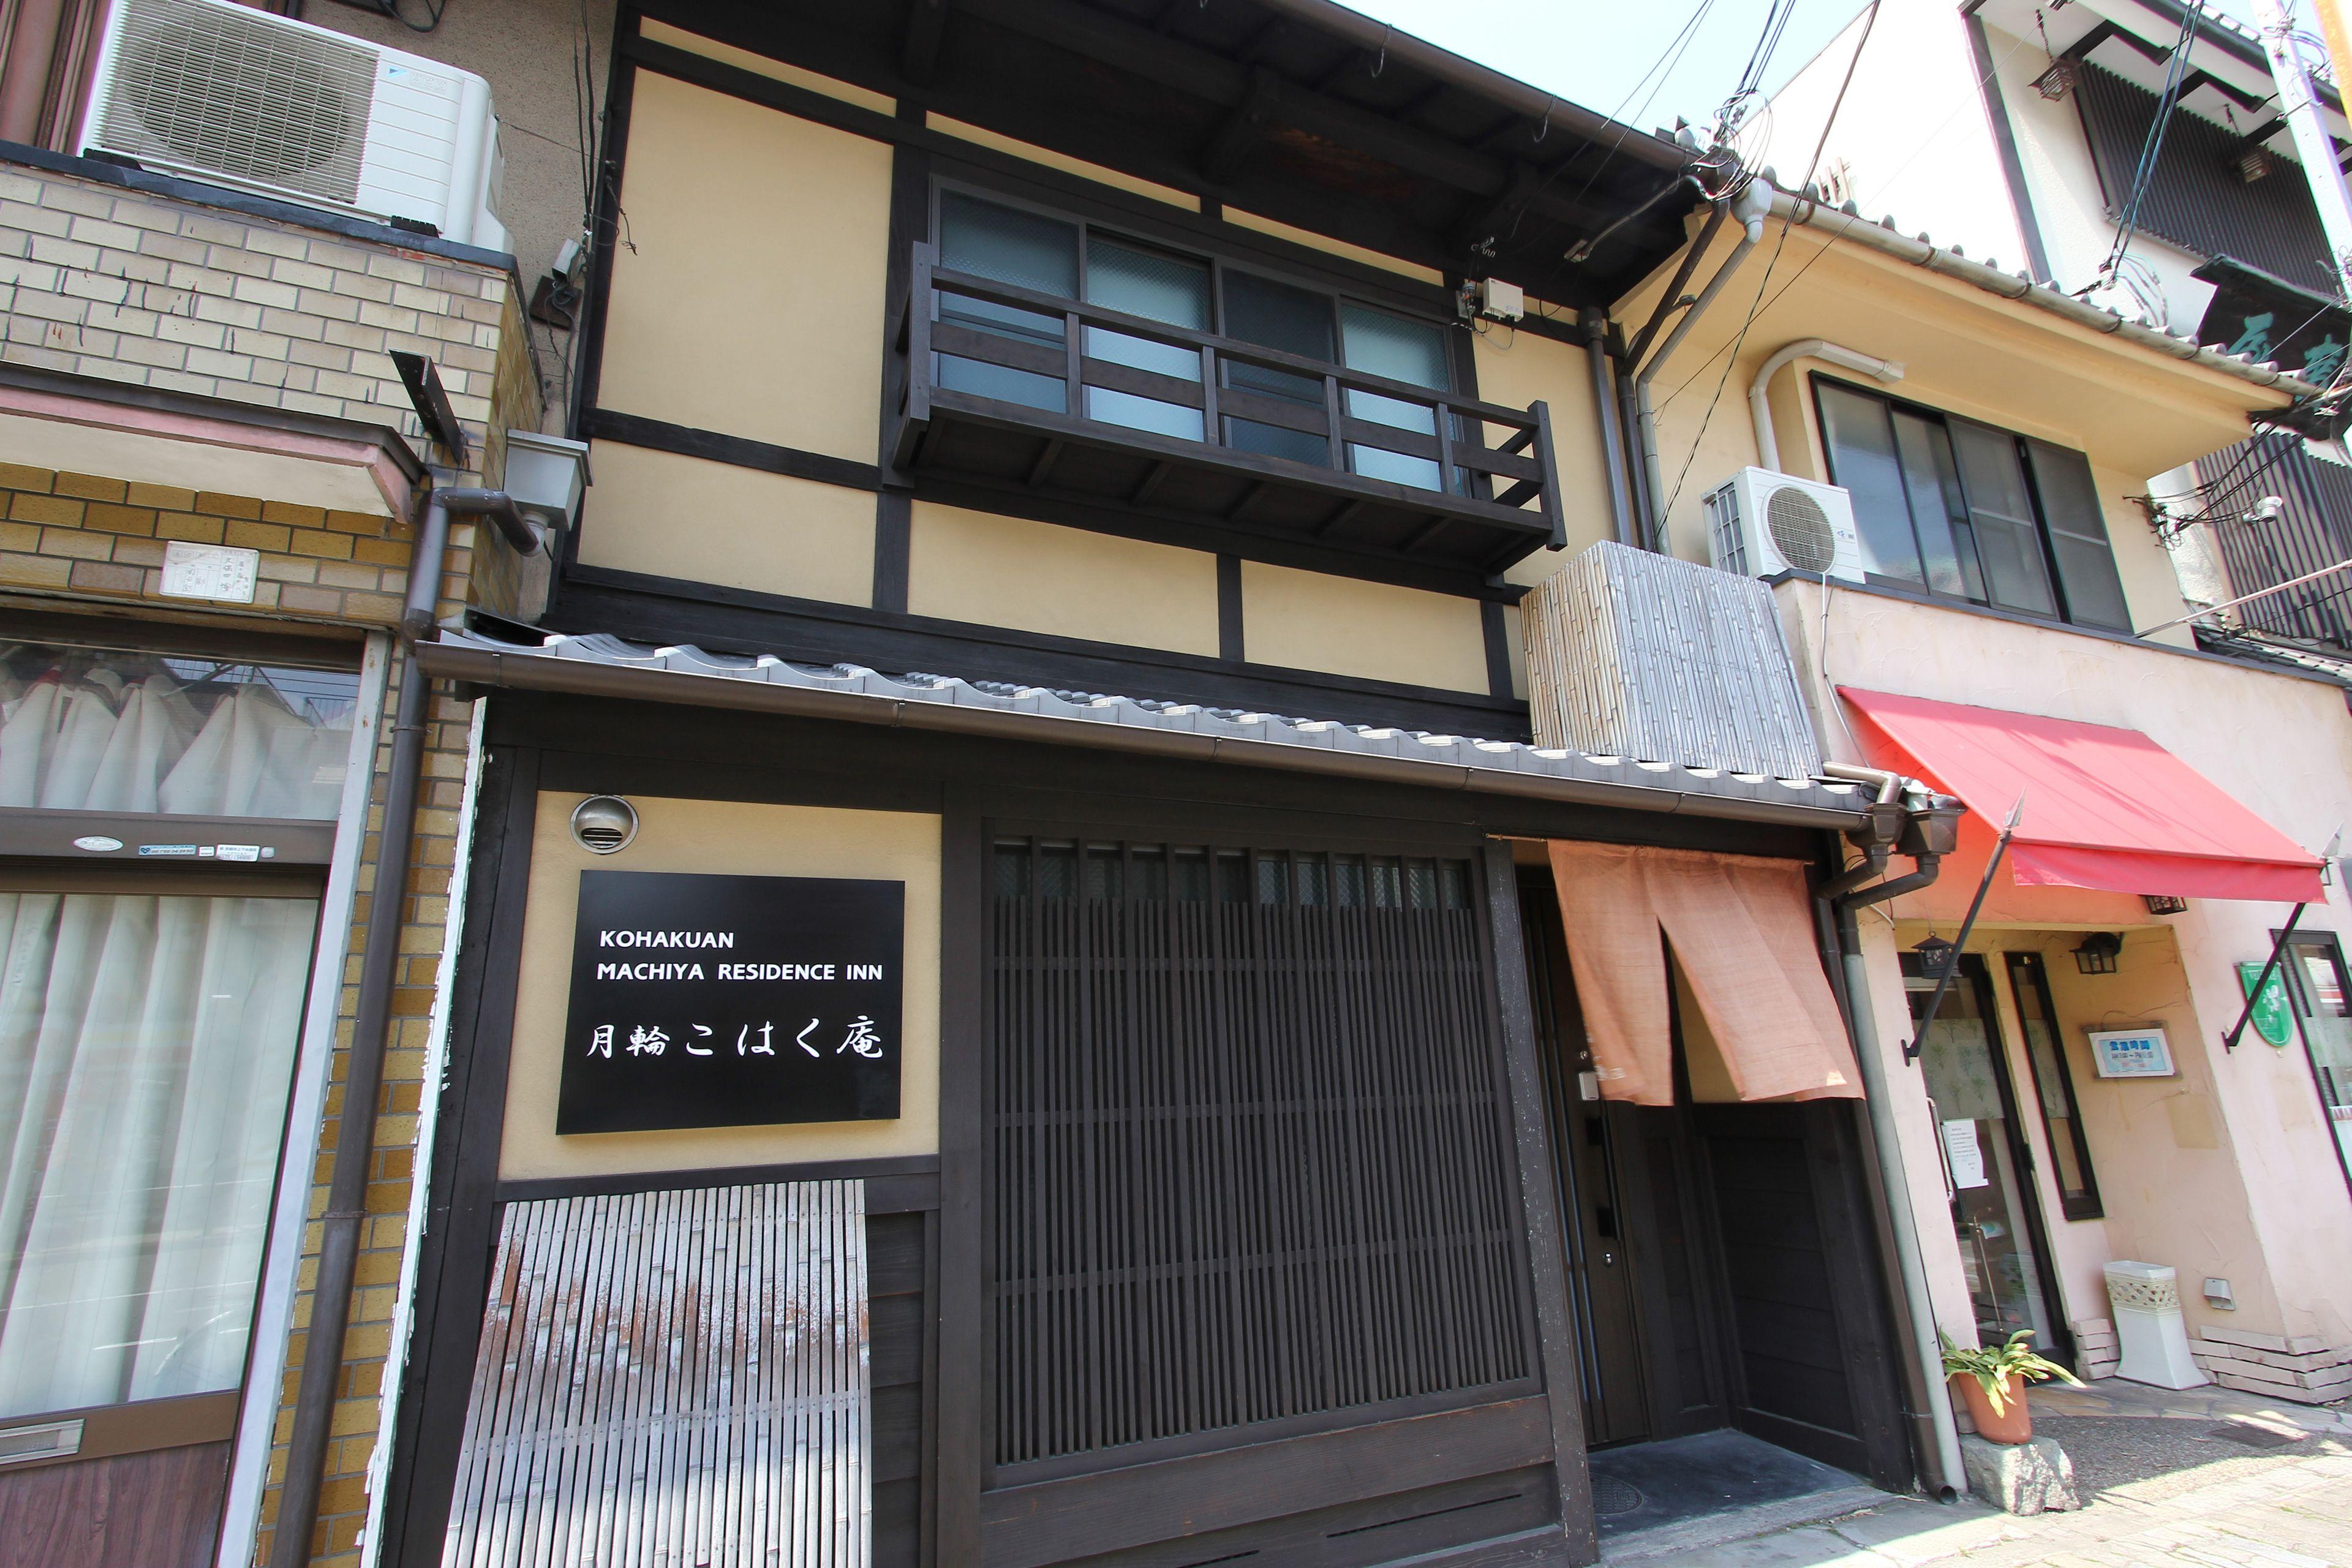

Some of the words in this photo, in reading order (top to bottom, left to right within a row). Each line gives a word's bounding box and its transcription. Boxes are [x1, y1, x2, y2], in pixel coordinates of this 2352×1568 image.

[600, 930, 734, 948] KOHAKUAN
[597, 963, 704, 980] MACHIYA
[718, 963, 835, 981] RESIDENCE
[846, 964, 883, 980] INN
[586, 1015, 883, 1059] 月輪こはく庵
